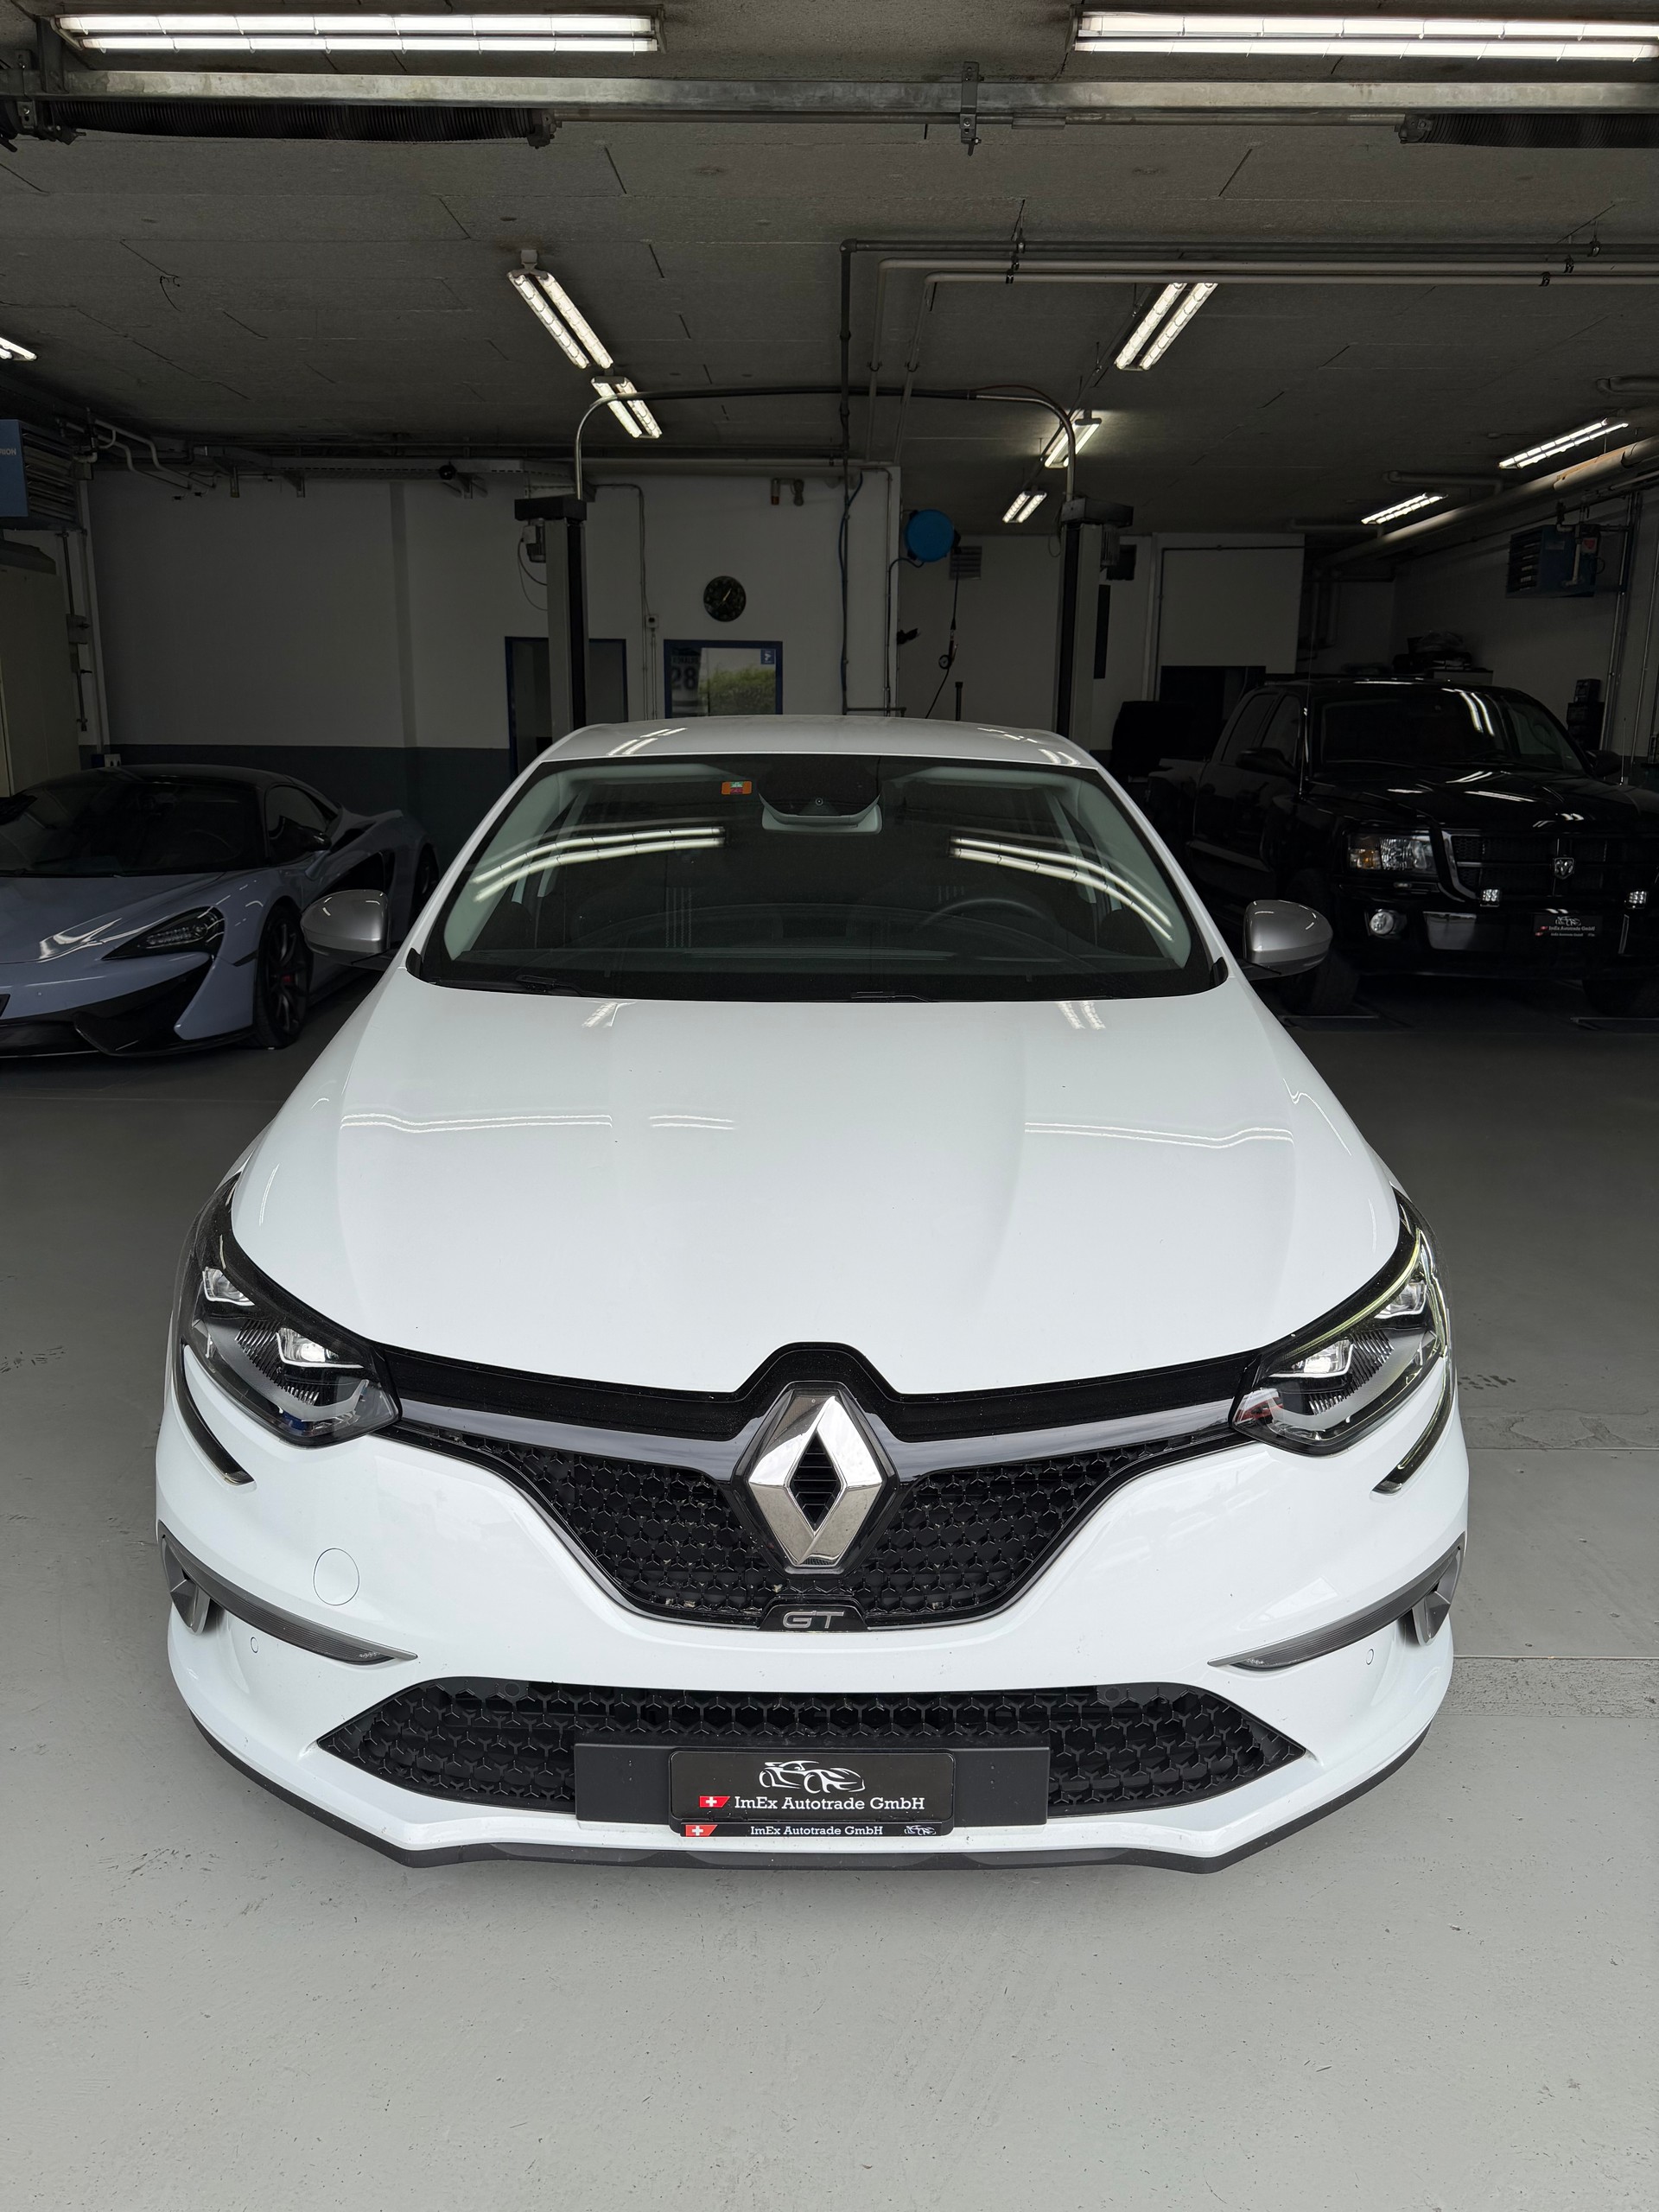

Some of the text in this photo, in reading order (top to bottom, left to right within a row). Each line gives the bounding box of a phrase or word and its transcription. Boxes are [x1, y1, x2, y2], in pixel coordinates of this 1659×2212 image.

[671, 666, 696, 690] 28
[782, 1610, 845, 1629] GT
[734, 1796, 925, 1810] ImEx Autotrade GmbH
[750, 1826, 883, 1835] ImEx Autotrade GmbH
